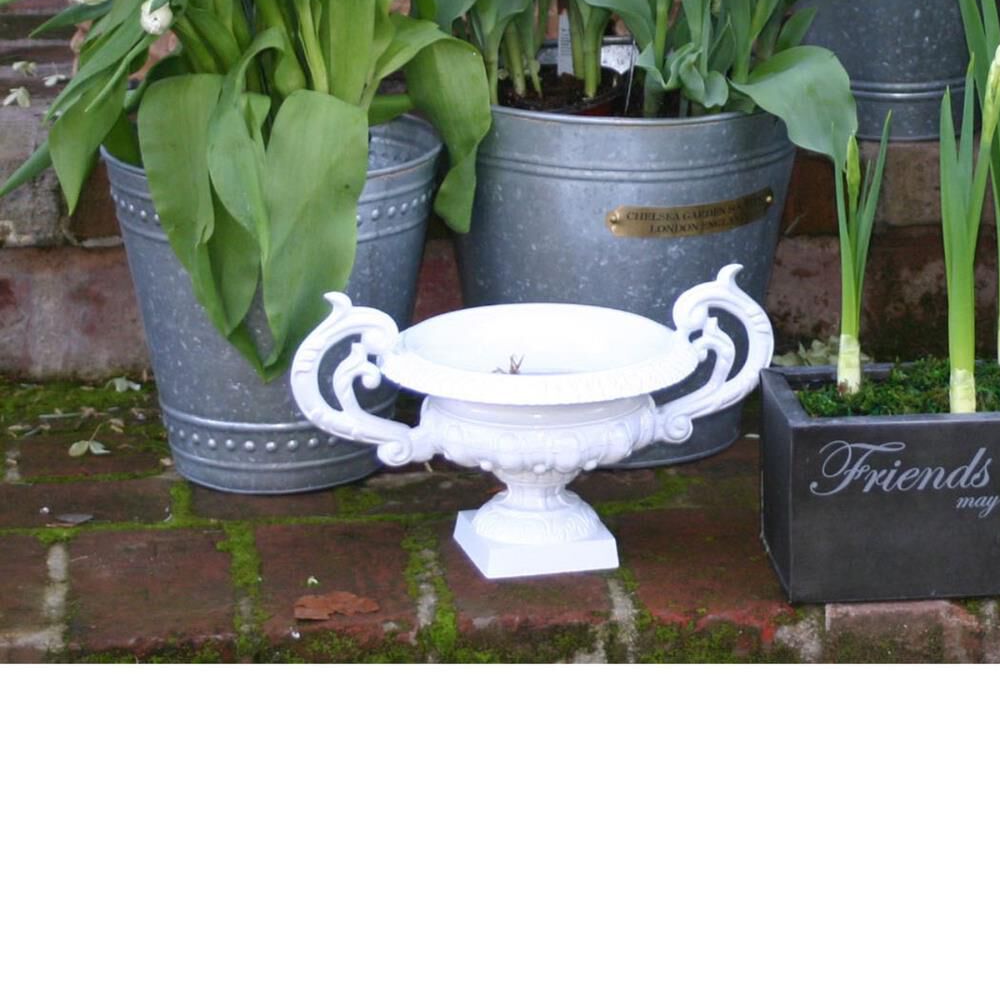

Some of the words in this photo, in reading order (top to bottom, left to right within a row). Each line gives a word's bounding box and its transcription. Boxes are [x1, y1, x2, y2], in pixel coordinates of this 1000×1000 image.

[626, 210, 681, 222] CHELSEA
[650, 222, 700, 233] LONDON
[809, 439, 993, 496] Friends
[956, 494, 1000, 518] may
